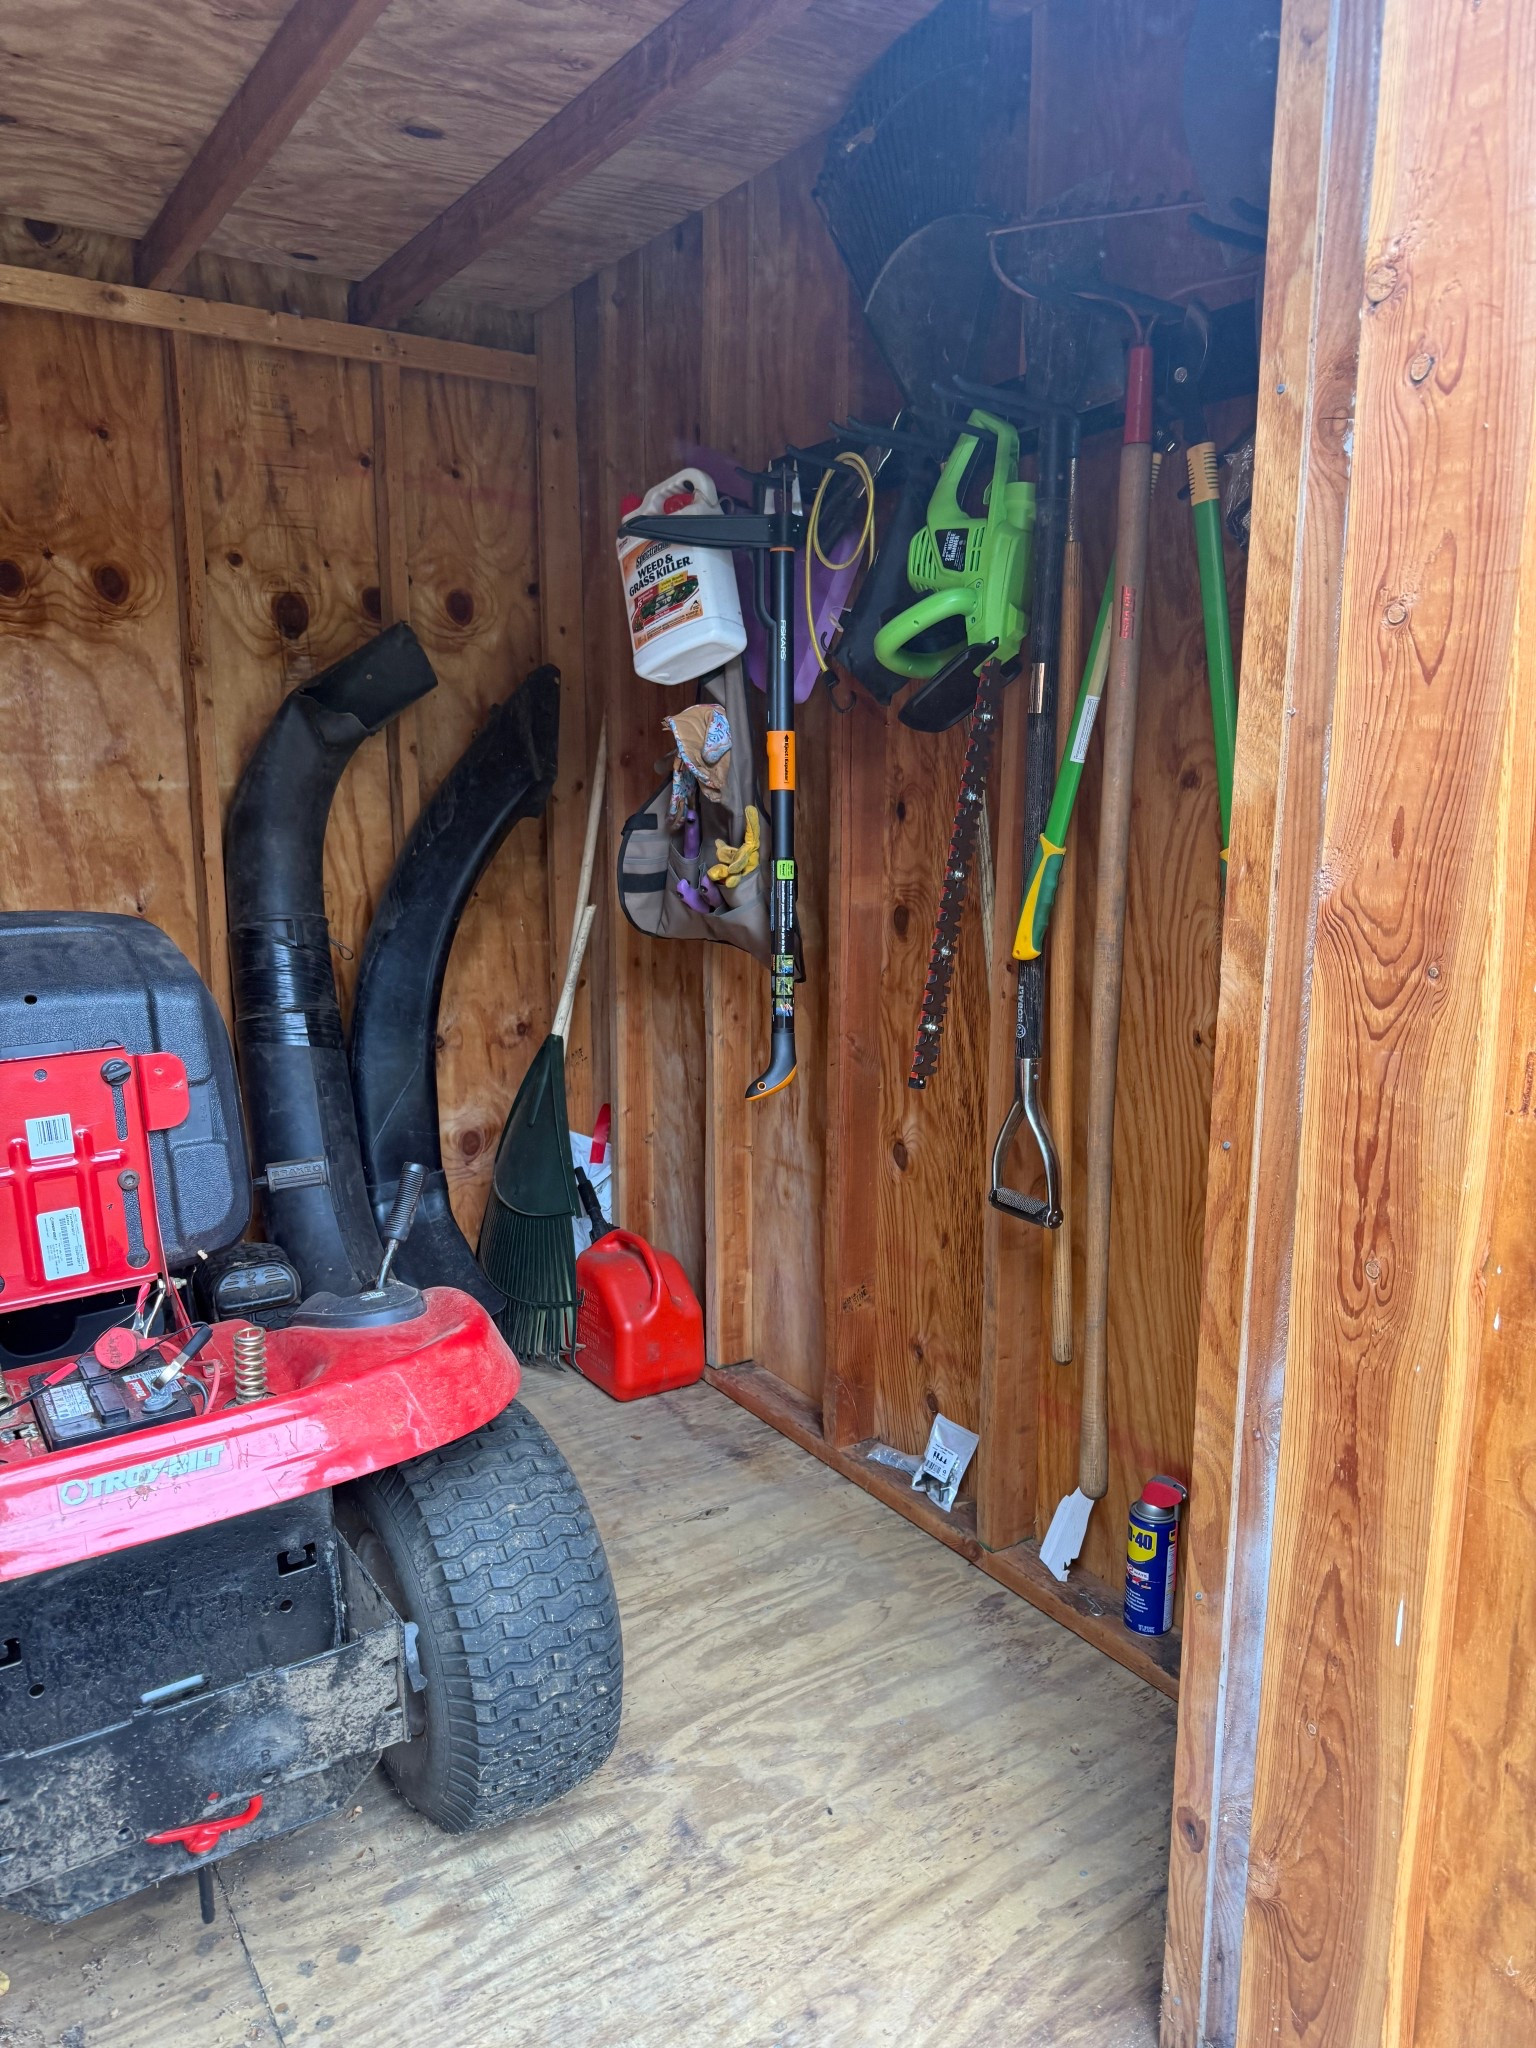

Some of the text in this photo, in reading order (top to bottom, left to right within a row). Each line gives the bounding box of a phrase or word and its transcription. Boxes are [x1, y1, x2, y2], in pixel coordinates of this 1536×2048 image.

[950, 535, 960, 561] TRIMMER
[629, 573, 656, 596] GRASS
[656, 556, 691, 578] KILLER
[637, 553, 673, 579] WEED &
[271, 1166, 312, 1178] BRAKE
[88, 1445, 225, 1498] TROY-BILT
[260, 1749, 271, 1764] B
